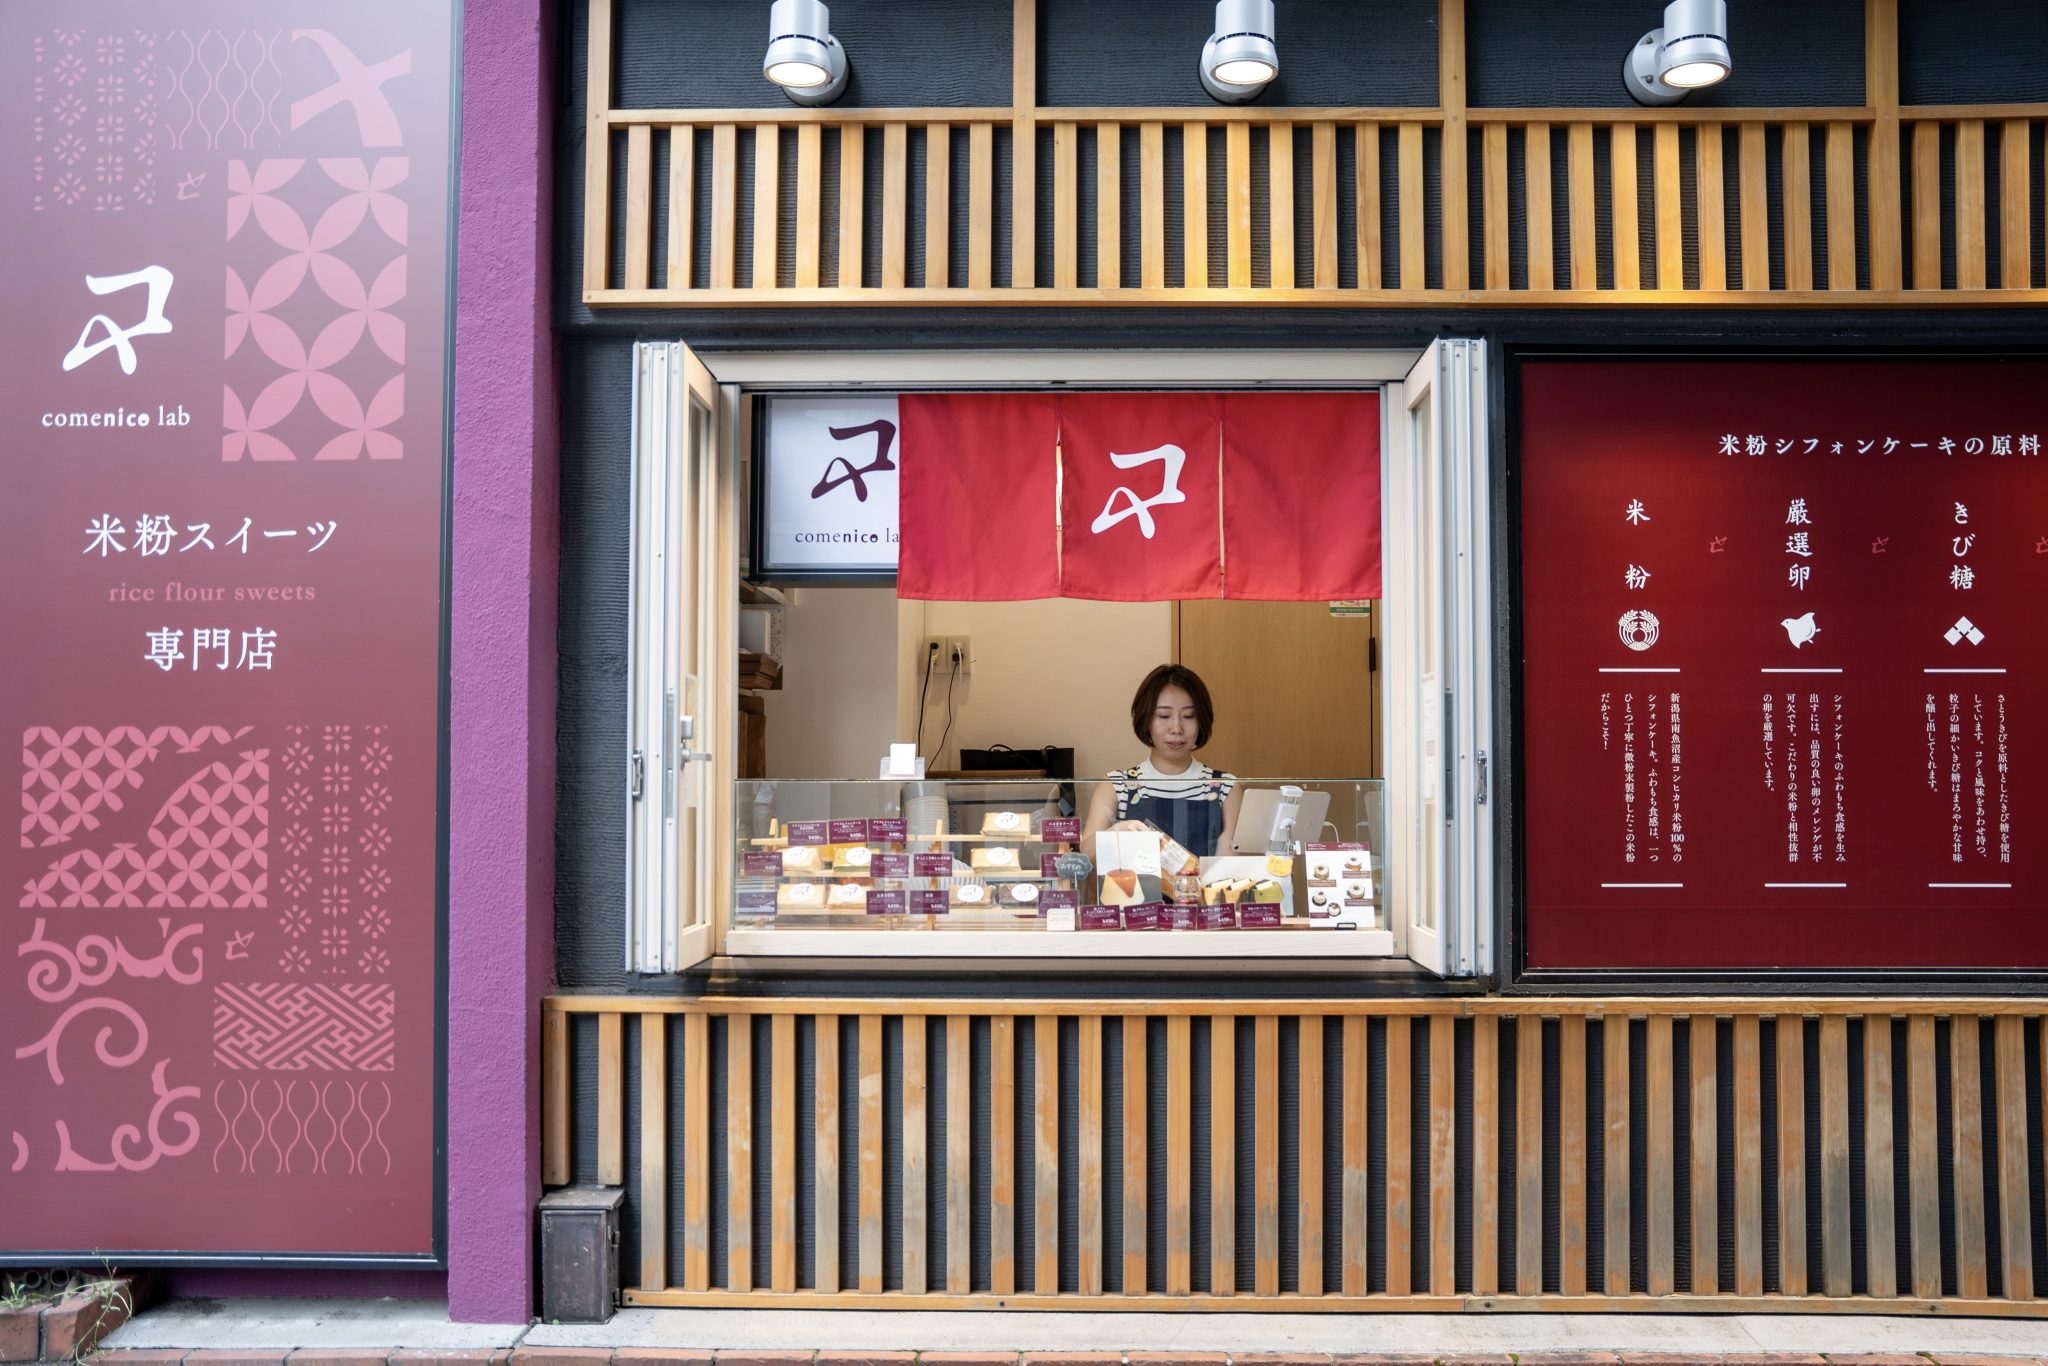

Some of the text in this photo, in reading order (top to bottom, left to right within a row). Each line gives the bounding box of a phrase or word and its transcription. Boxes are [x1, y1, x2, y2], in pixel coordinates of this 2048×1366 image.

[41, 404, 191, 428] comenico lab
[1717, 433, 2042, 457] 米粉シフォンケーキの原料
[82, 513, 338, 558] 米粉スイーツ
[794, 527, 900, 544] comenico la
[1624, 498, 1652, 590] 米粉
[1784, 498, 1814, 591] 厳選卵
[1948, 501, 1977, 591] きび糖
[109, 582, 316, 602] rice flour sweets
[143, 626, 278, 672] 専門店
[1762, 693, 1775, 792] の卵を厳選しています。
